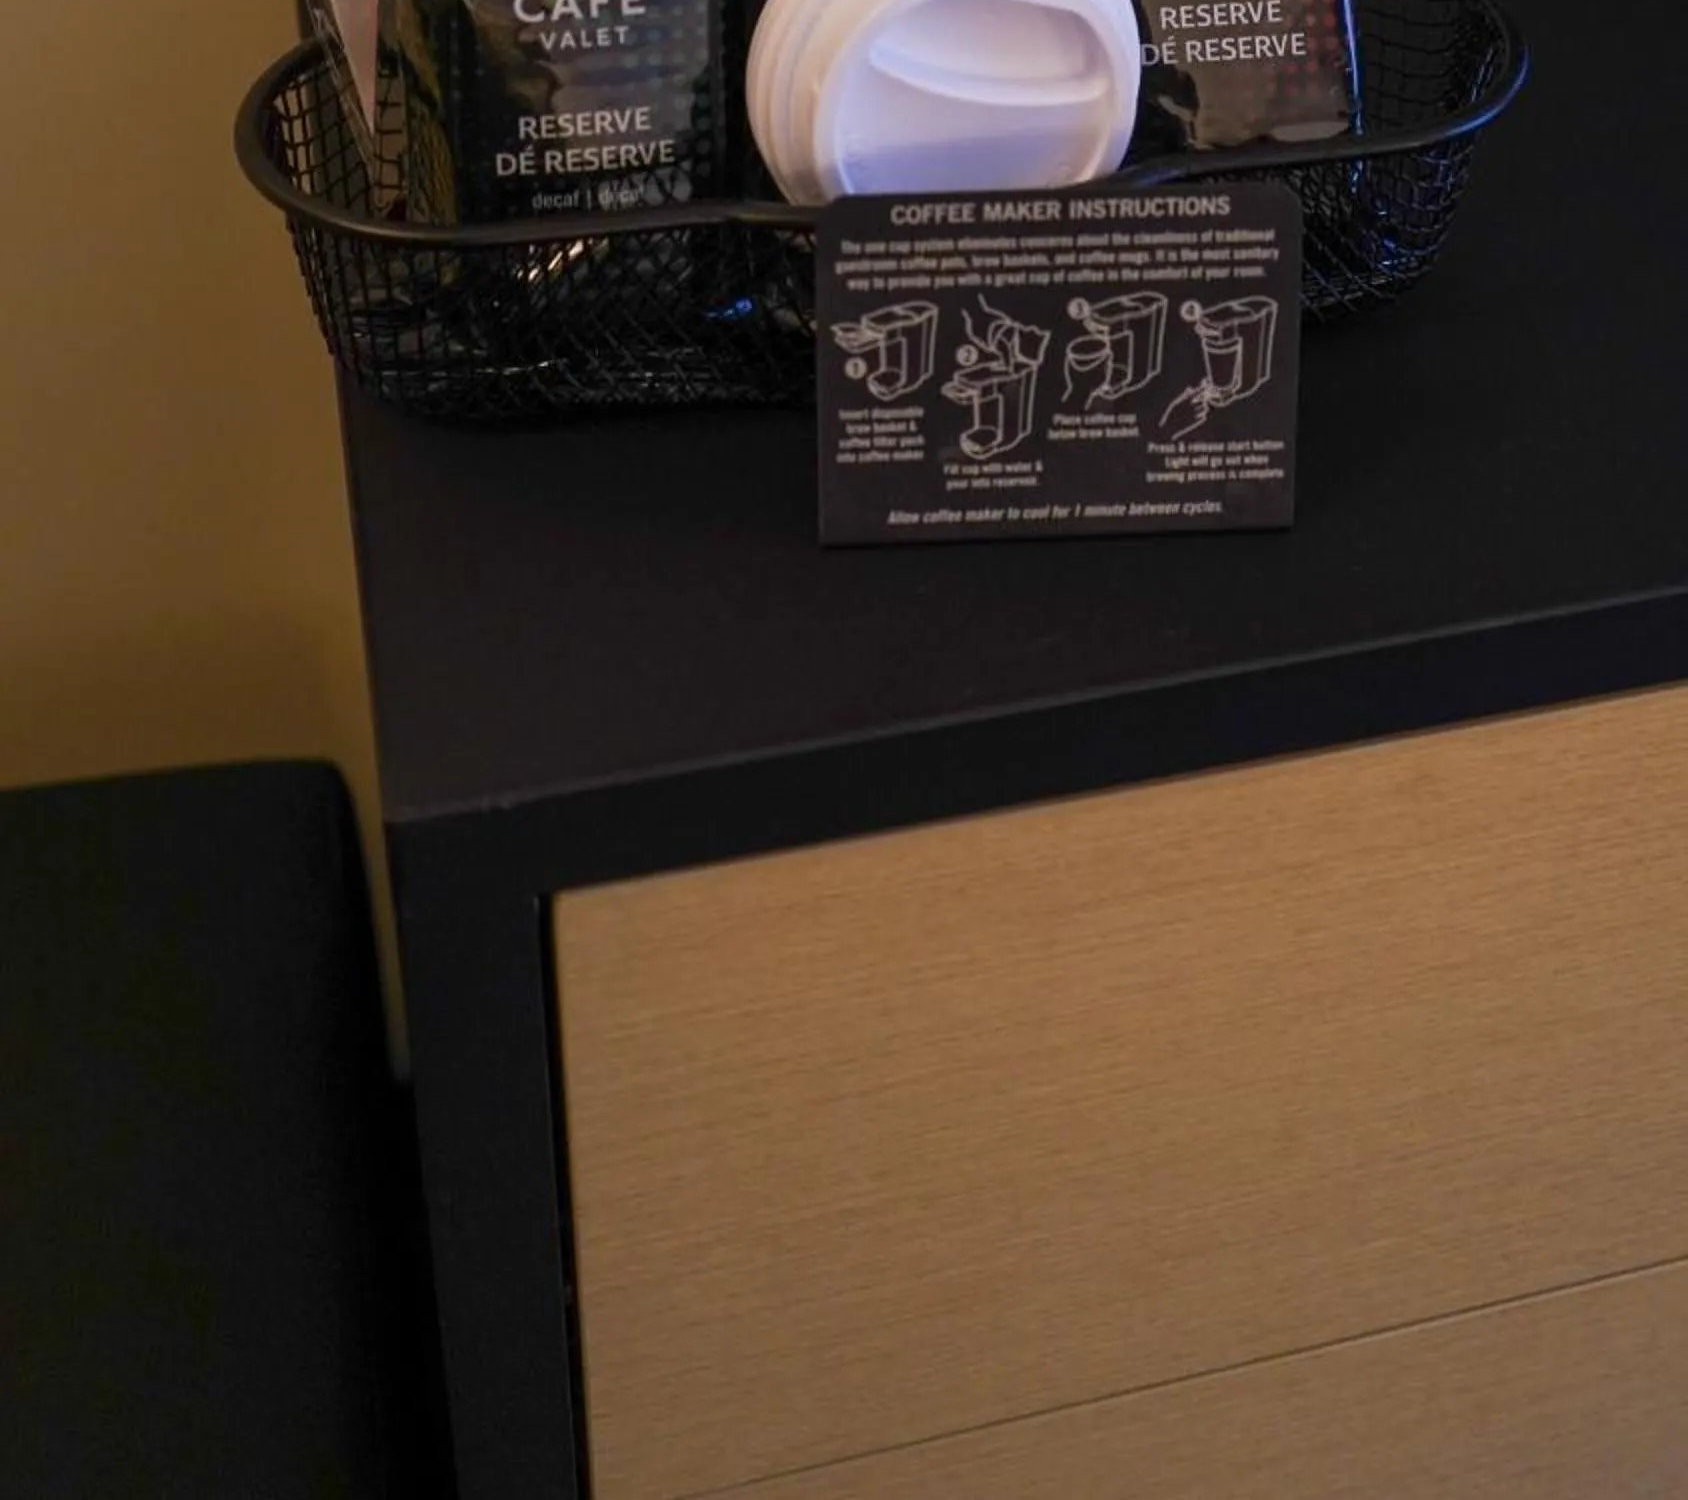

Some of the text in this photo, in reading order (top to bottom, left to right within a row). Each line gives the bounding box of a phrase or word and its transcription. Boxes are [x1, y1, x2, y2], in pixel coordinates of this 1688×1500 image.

[1160, 0, 1282, 28] RESERVE
[539, 26, 629, 51] VALET
[1141, 32, 1306, 66] DÉ RESERVE
[518, 106, 651, 140] RESERVE
[495, 139, 676, 177] DÉ RESERVE
[890, 195, 1231, 225] COFFEE MAKER INSTRUCTIONS
[1067, 268, 1104, 283] coffee
[887, 509, 920, 525] Allow
[922, 507, 962, 524] coffee
[965, 505, 1005, 522] maker
[1007, 506, 1020, 521] to
[1022, 503, 1050, 520] cool
[1052, 503, 1071, 519] for
[1073, 503, 1081, 518] 1
[1083, 502, 1126, 518] minute
[1128, 500, 1180, 517] between
